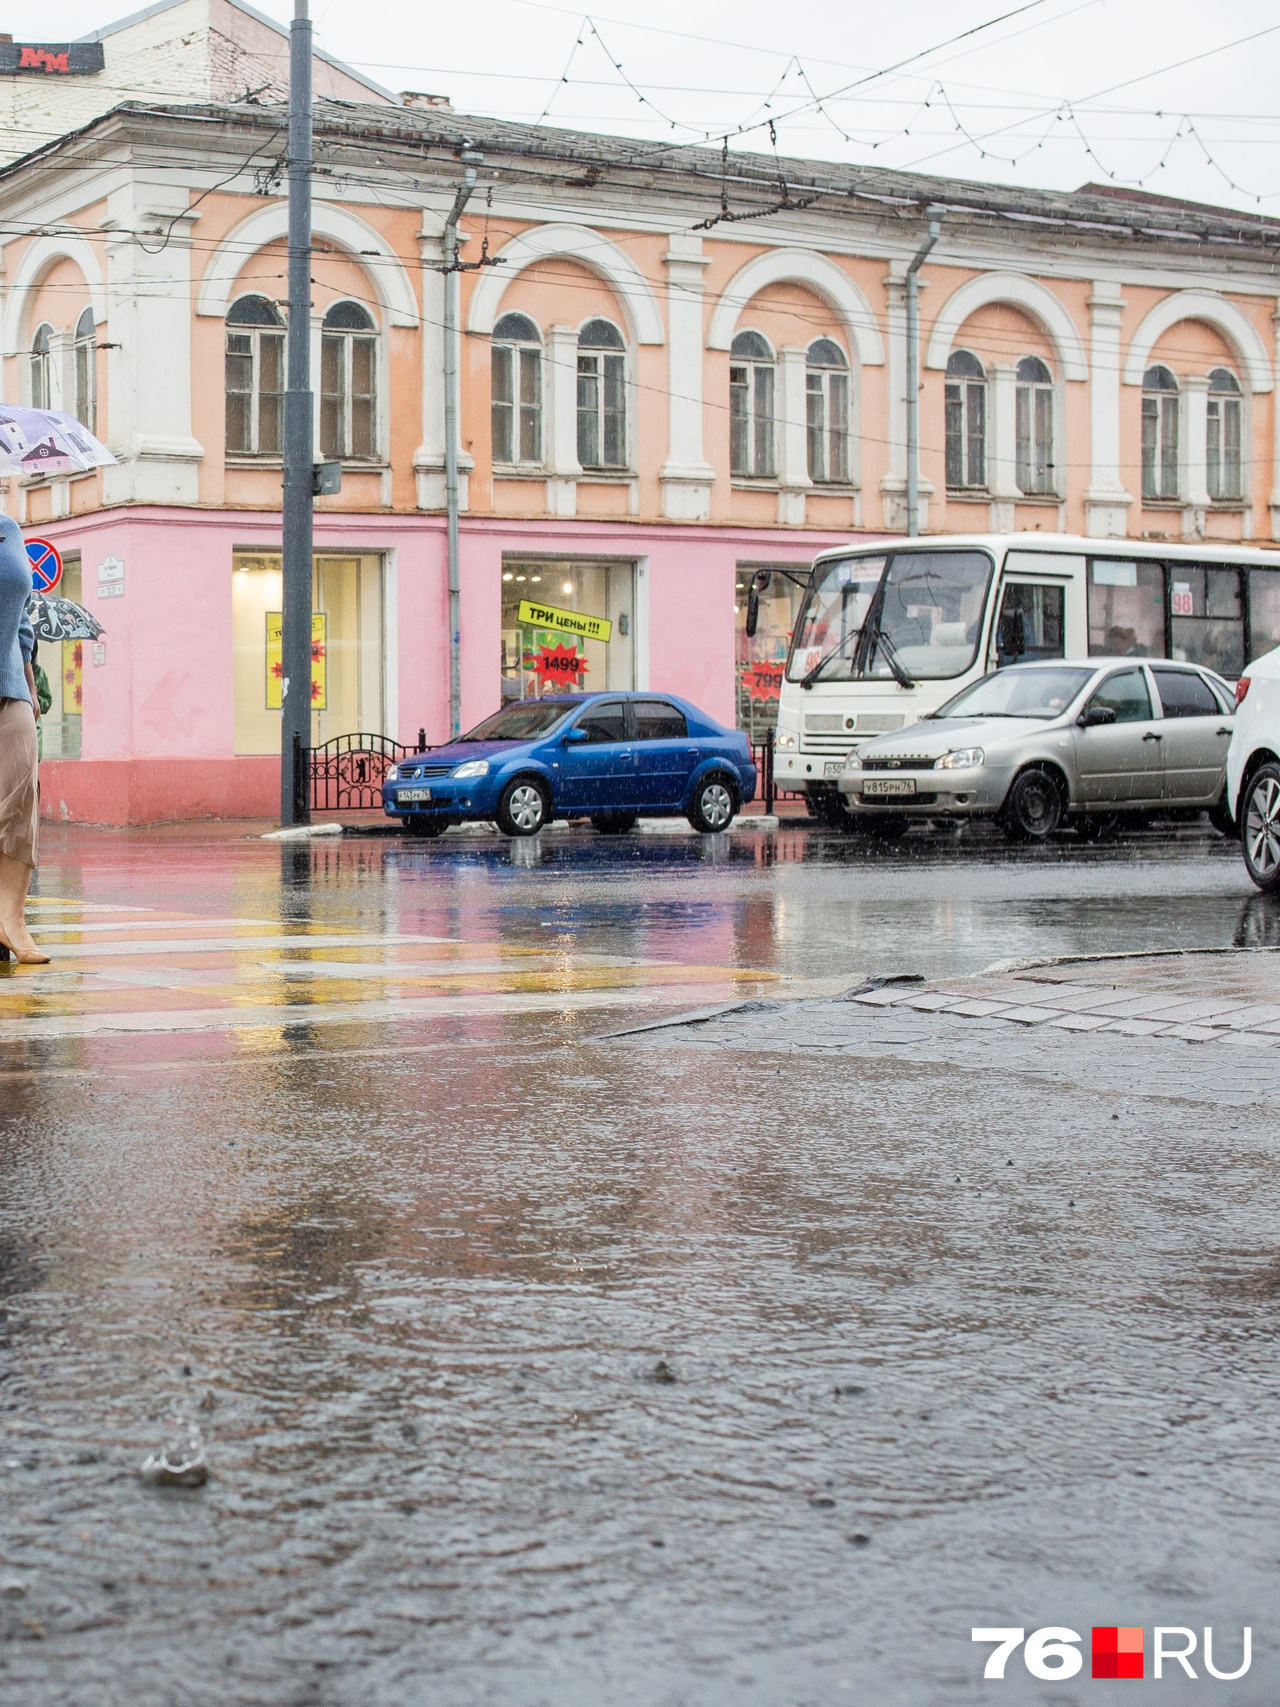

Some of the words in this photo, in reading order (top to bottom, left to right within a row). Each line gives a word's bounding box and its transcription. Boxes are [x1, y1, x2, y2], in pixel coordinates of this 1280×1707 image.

[1173, 593, 1192, 613] 98
[529, 607, 554, 623] ТРИ
[555, 616, 587, 631] ЦЕНЫ
[587, 621, 600, 635] !!!
[543, 656, 580, 672] 1499
[805, 650, 821, 673] 98
[753, 671, 783, 689] 799
[866, 781, 900, 793] У815РН
[902, 781, 912, 790] 76
